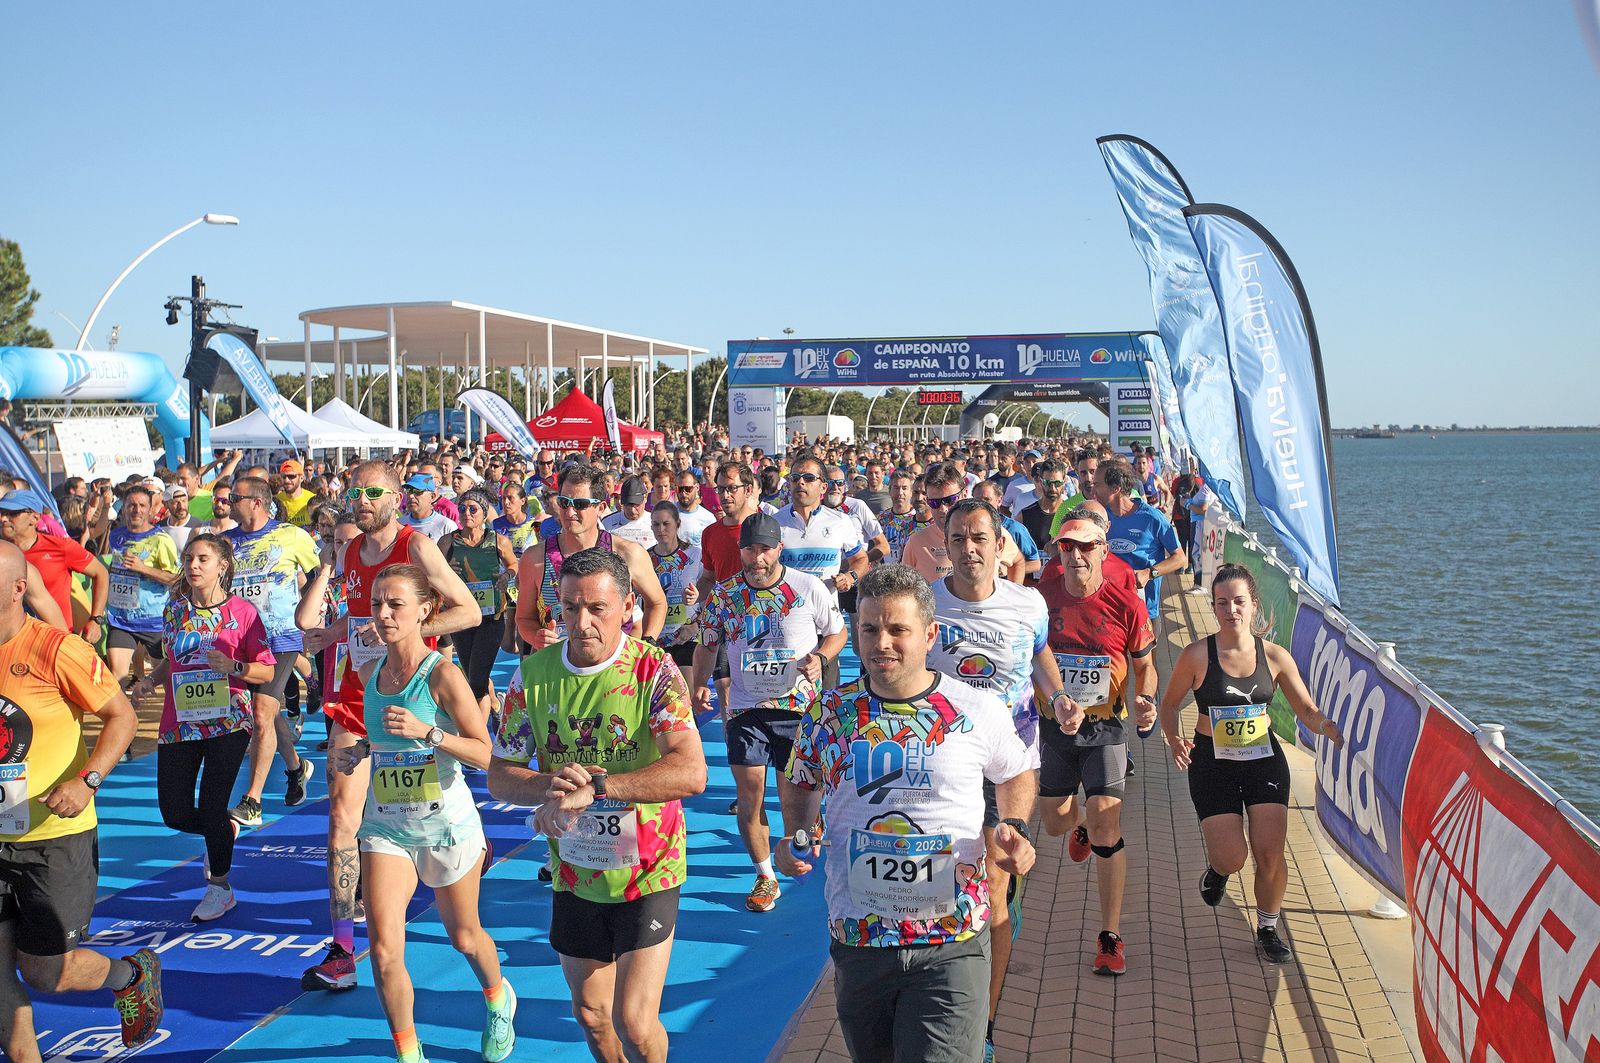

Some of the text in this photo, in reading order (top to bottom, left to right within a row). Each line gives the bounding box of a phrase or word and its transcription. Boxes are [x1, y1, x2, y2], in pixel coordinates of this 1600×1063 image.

[874, 342, 970, 355] CAMPEONATO
[874, 353, 1005, 370] de ESPAÑA 10 km
[1017, 344, 1081, 375] 10 HUELVA
[836, 368, 858, 376] WiHu
[937, 370, 970, 378] Absoluto
[111, 584, 134, 596] 1521
[232, 585, 262, 598] 1153
[964, 631, 1006, 643] HUELVA
[751, 663, 788, 676] 1757
[1060, 668, 1101, 685] 1759
[185, 683, 216, 699] 904
[1225, 720, 1256, 736] 875
[906, 756, 934, 772] EL
[0, 768, 19, 778] 023
[379, 768, 426, 788] 1167
[851, 739, 936, 804] 10 HU
[906, 772, 932, 787] VA
[915, 840, 944, 852] 2023
[866, 856, 933, 883] 1291
[889, 886, 913, 894] PEDRO
[893, 905, 919, 914] Syriuz
[78, 928, 334, 958] Huelva
